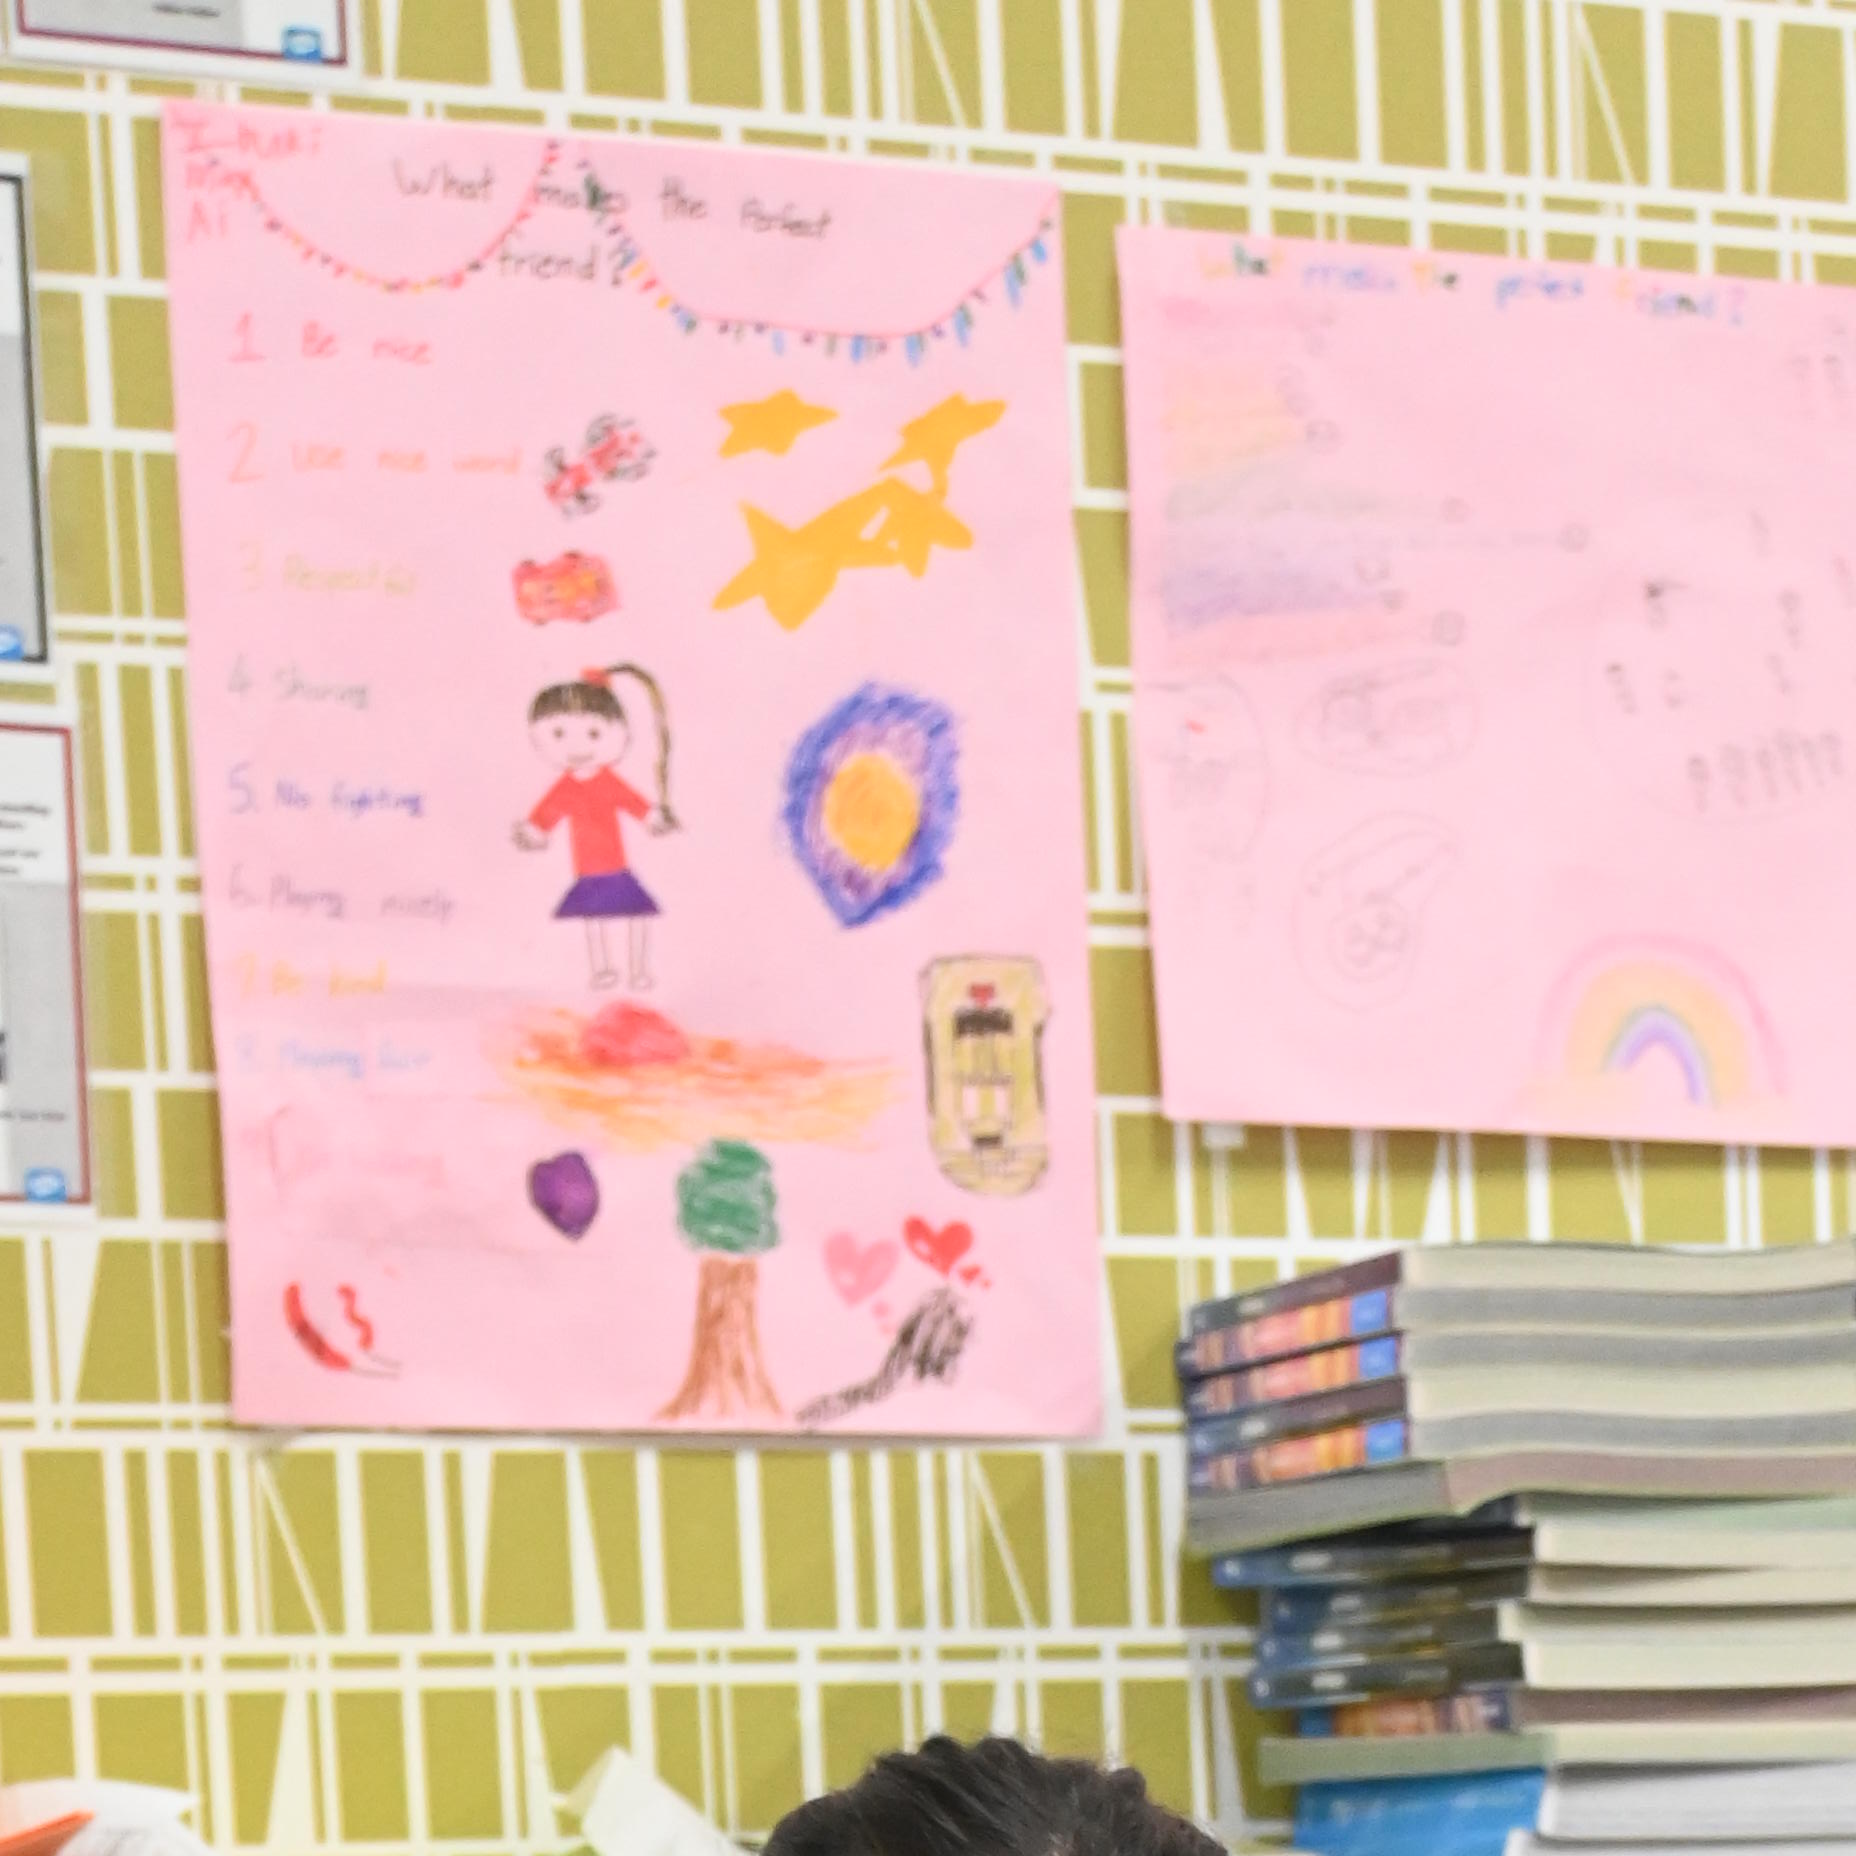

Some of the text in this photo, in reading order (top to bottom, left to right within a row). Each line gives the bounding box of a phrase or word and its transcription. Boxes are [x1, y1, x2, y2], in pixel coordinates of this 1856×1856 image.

[393, 156, 494, 202] What
[659, 176, 708, 220] the
[229, 311, 433, 366] 1 Be nice
[225, 419, 267, 484] 2
